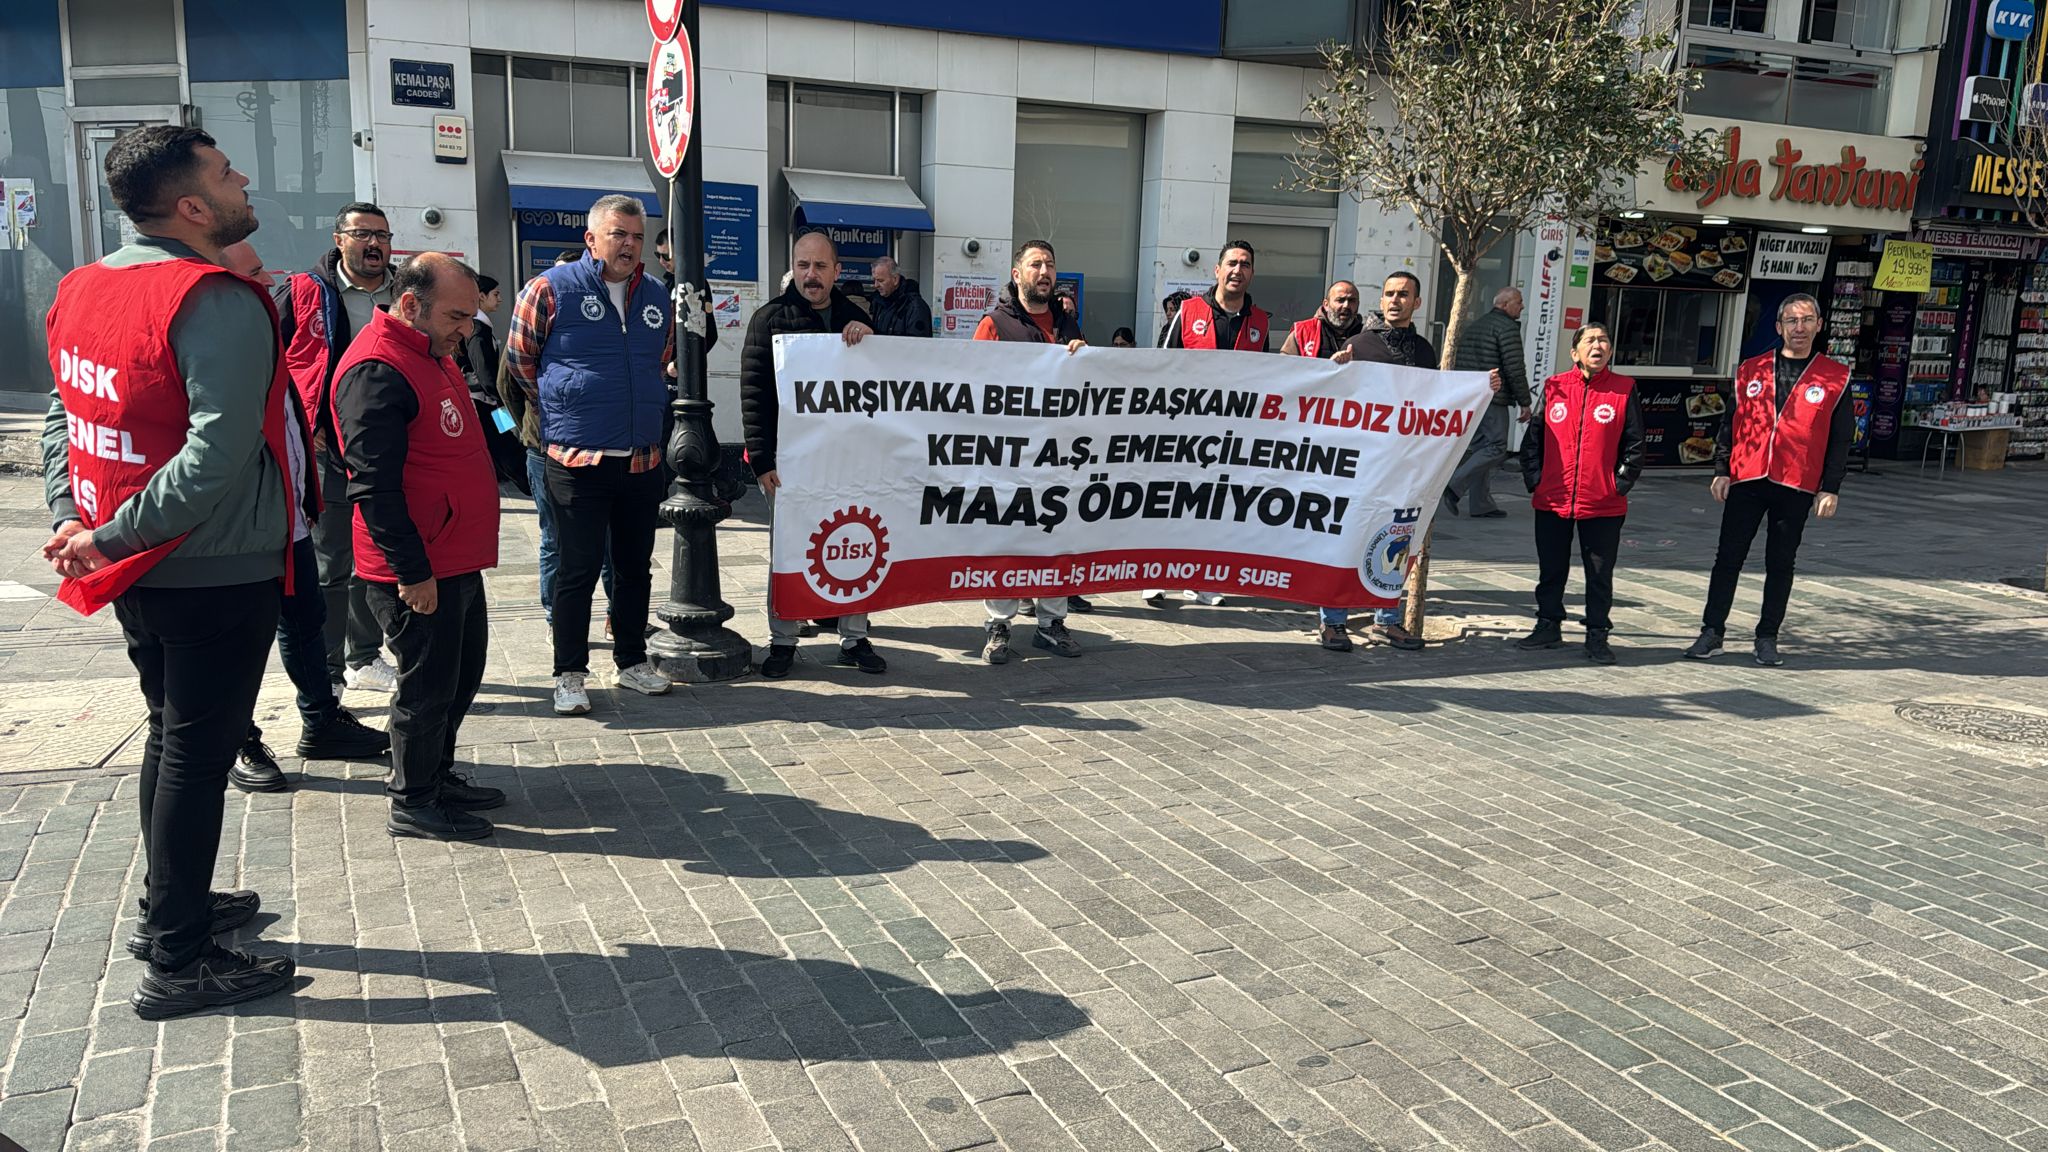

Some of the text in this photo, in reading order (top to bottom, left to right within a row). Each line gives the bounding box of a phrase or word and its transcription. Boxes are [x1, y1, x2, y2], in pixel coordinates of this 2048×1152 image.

[1995, 10, 2033, 28] KVK
[394, 72, 451, 92] KEMALPAŞA
[406, 89, 440, 99] CADDESİ
[1980, 93, 2006, 107] iPhone
[1769, 138, 1925, 211] tantuni
[1970, 154, 2043, 197] MESSE
[557, 211, 588, 228] Yapı
[826, 227, 883, 244] YapıKredi
[1759, 234, 1786, 252] NİGET
[1924, 230, 1962, 245] MESSE
[1760, 255, 1819, 276] İŞ HANI No:7
[955, 285, 985, 298] EMEĞİN
[955, 299, 985, 310] OLACAK
[60, 346, 120, 402] DİSK
[794, 380, 975, 418] KARŞIYAKA
[982, 381, 1126, 418] BELEDİYE
[1128, 388, 1259, 420] BAŞKANI
[1259, 394, 1287, 420] B.
[1298, 396, 1394, 433] YILDIZ
[66, 411, 146, 465] ENEL
[928, 430, 1360, 478] KENT A.Ş. EMEKÇİLERİNE
[72, 465, 98, 522] İŞ
[920, 473, 1350, 535] MAAŞ ÖDEMİYOR!
[826, 537, 873, 561] DİSK
[950, 566, 997, 589] DİSK
[1002, 563, 1085, 587] GENEL-İŞ
[1089, 560, 1138, 581] İZMİR
[1142, 563, 1162, 578] 10
[1204, 563, 1231, 581] LU
[1237, 567, 1292, 589] ŞUBE
